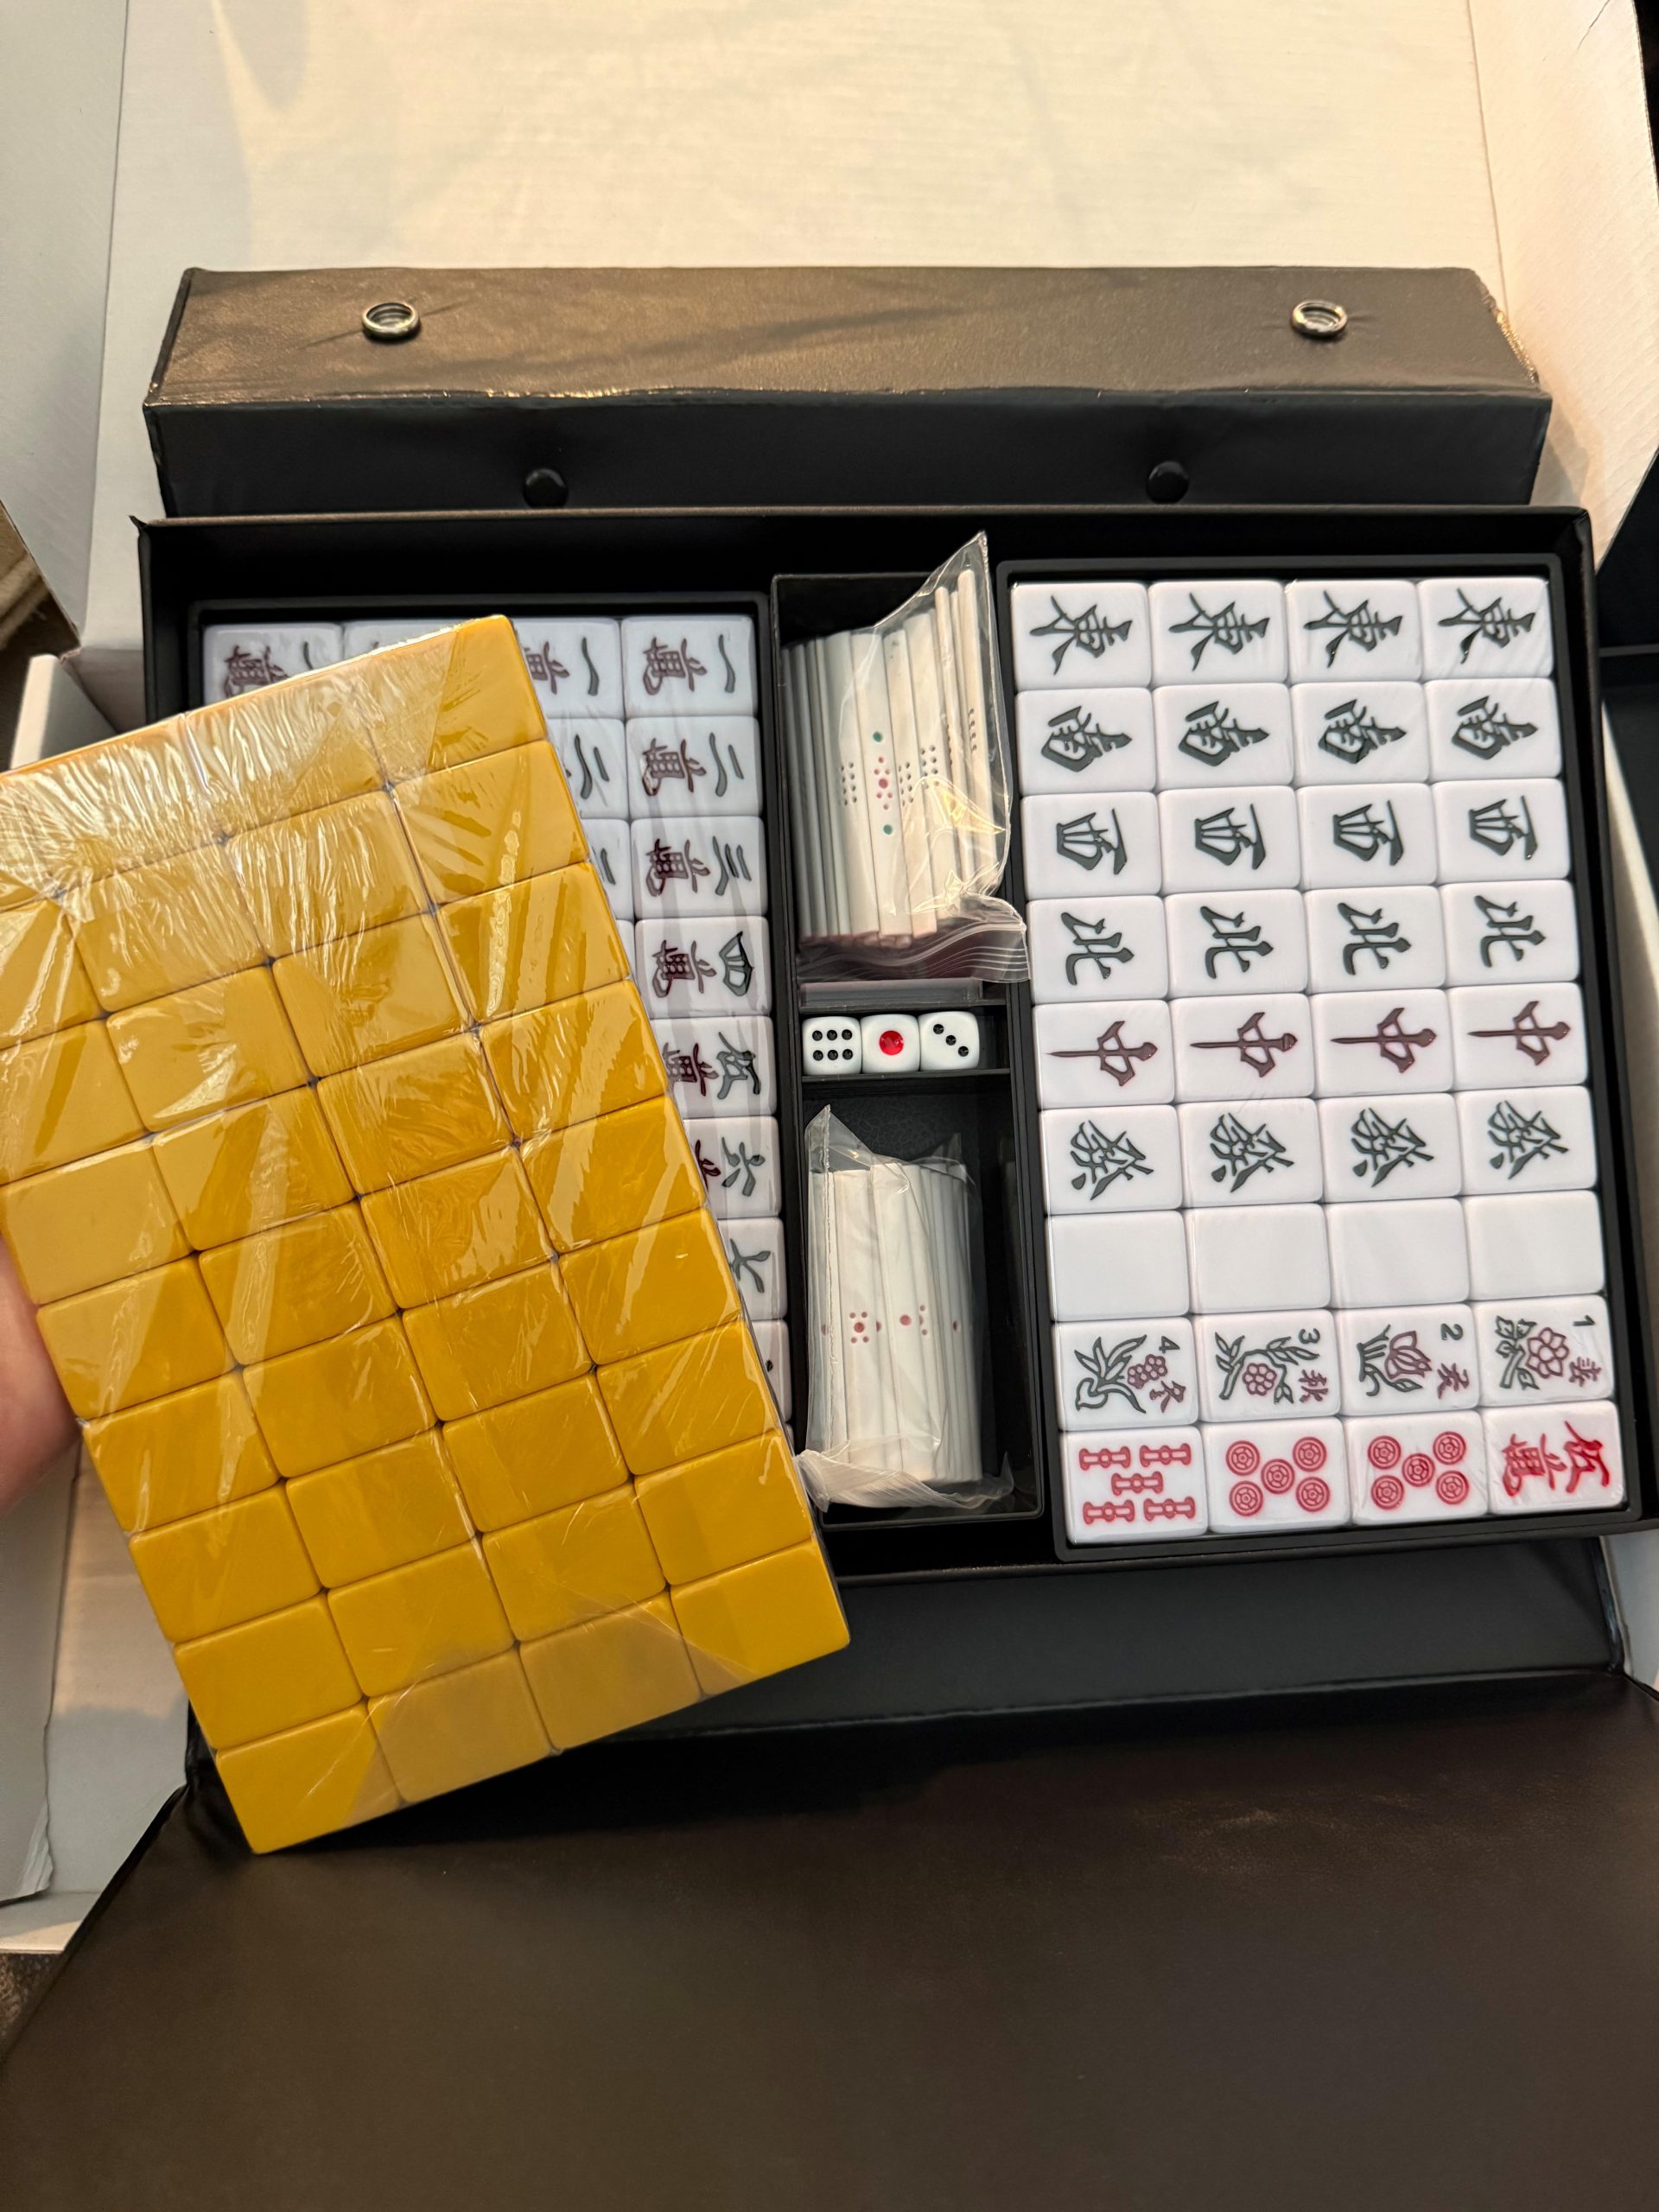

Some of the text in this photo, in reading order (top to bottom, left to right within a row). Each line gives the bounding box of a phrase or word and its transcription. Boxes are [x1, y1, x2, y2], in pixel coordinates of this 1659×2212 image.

[1030, 596, 1132, 674] 東
[1169, 594, 1269, 671] 東
[1304, 591, 1402, 667] 東
[1439, 589, 1535, 664] 東
[643, 635, 735, 695] 一萬
[1041, 706, 1132, 772] 南
[1179, 701, 1269, 766] 南
[1319, 699, 1407, 764] 南
[1452, 696, 1537, 760] 南
[566, 734, 610, 800] 二
[642, 733, 744, 797] 二萬
[1057, 809, 1127, 874] 西
[1195, 804, 1266, 869] 西
[1333, 801, 1404, 865] 西
[1469, 797, 1537, 860] 西
[646, 836, 752, 896] 三萬
[652, 931, 753, 997] 四萬
[1061, 912, 1134, 985] 北
[1200, 906, 1274, 979] 北
[1338, 903, 1411, 975] 北
[1475, 896, 1546, 967] 北
[1045, 1020, 1157, 1086] 中
[1191, 1012, 1298, 1077] 中
[1331, 1007, 1436, 1073] 中
[1469, 1001, 1570, 1065] 中
[1159, 1336, 1179, 1353] 4
[1441, 1324, 1463, 1340] 2
[1574, 1315, 1595, 1326] 1
[1299, 1329, 1328, 1402] 3 秋
